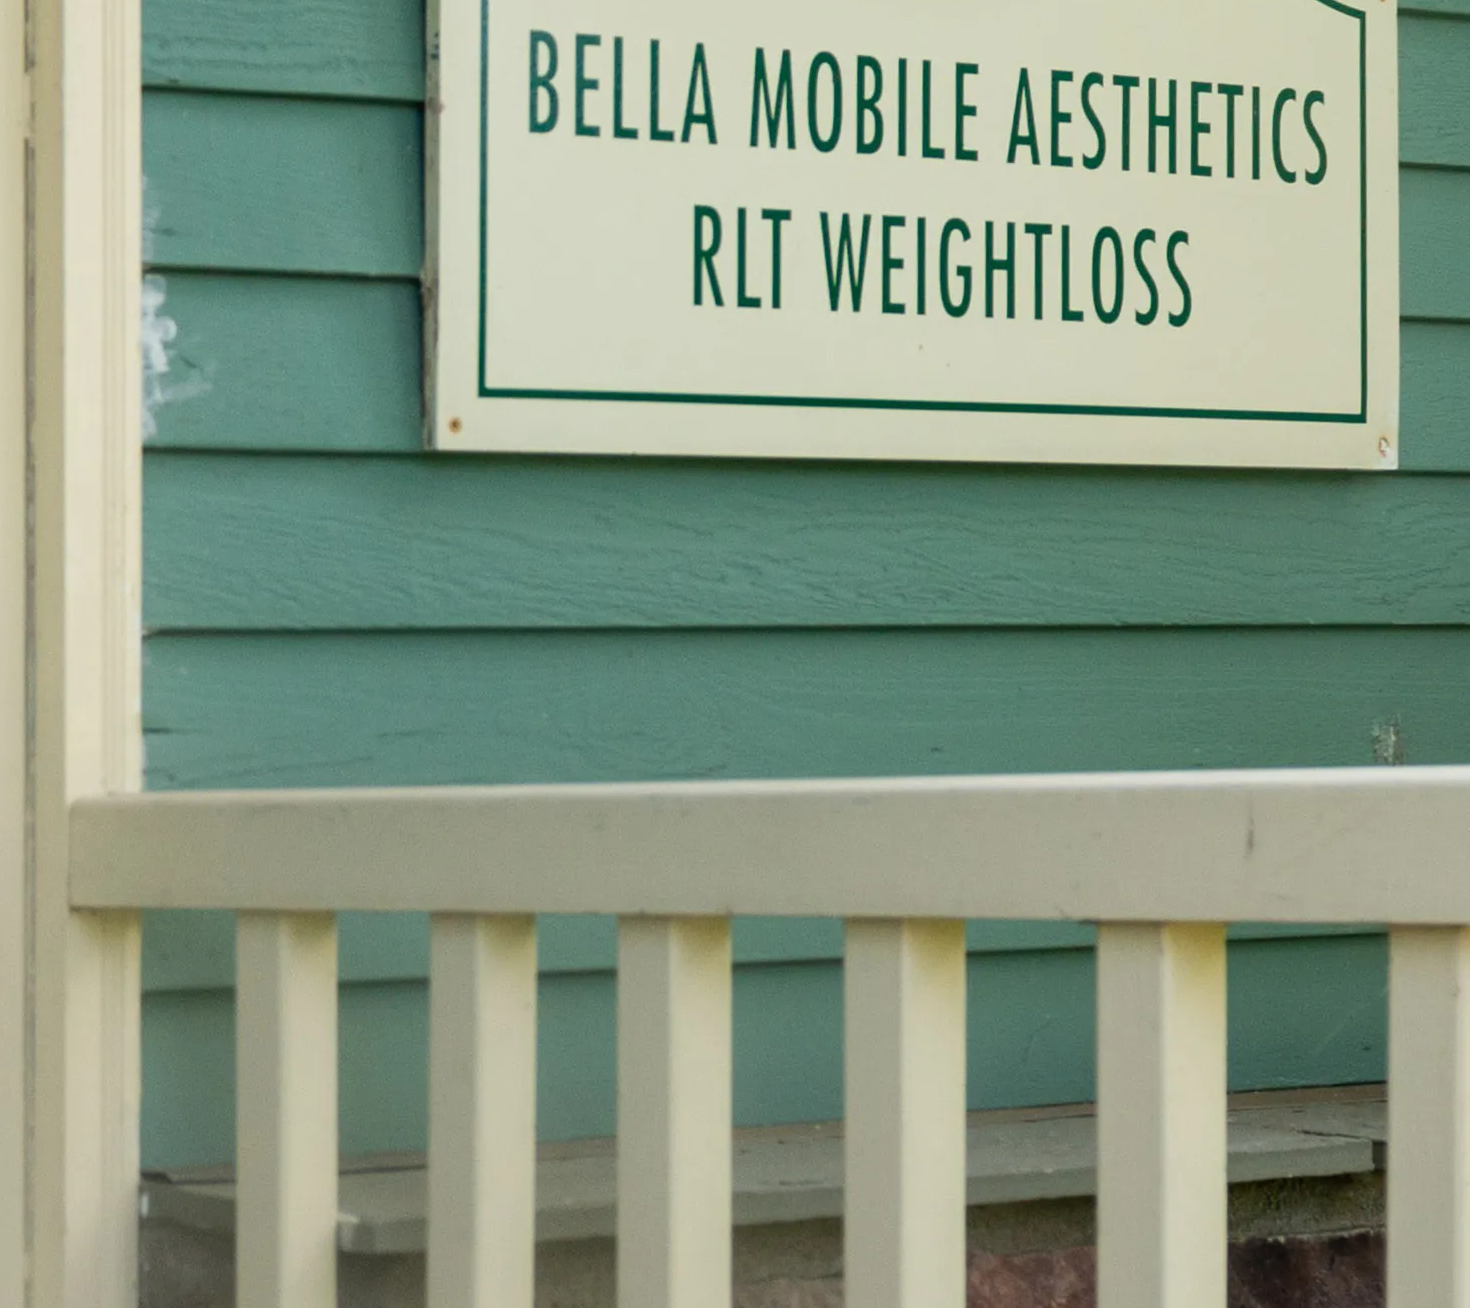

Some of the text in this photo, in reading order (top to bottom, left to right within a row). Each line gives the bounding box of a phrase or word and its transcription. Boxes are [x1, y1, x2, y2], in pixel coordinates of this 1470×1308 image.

[528, 29, 1329, 185] BELLA MOBILE AESTHETICS
[692, 204, 1194, 328] RLT WEIGHTLOSS
